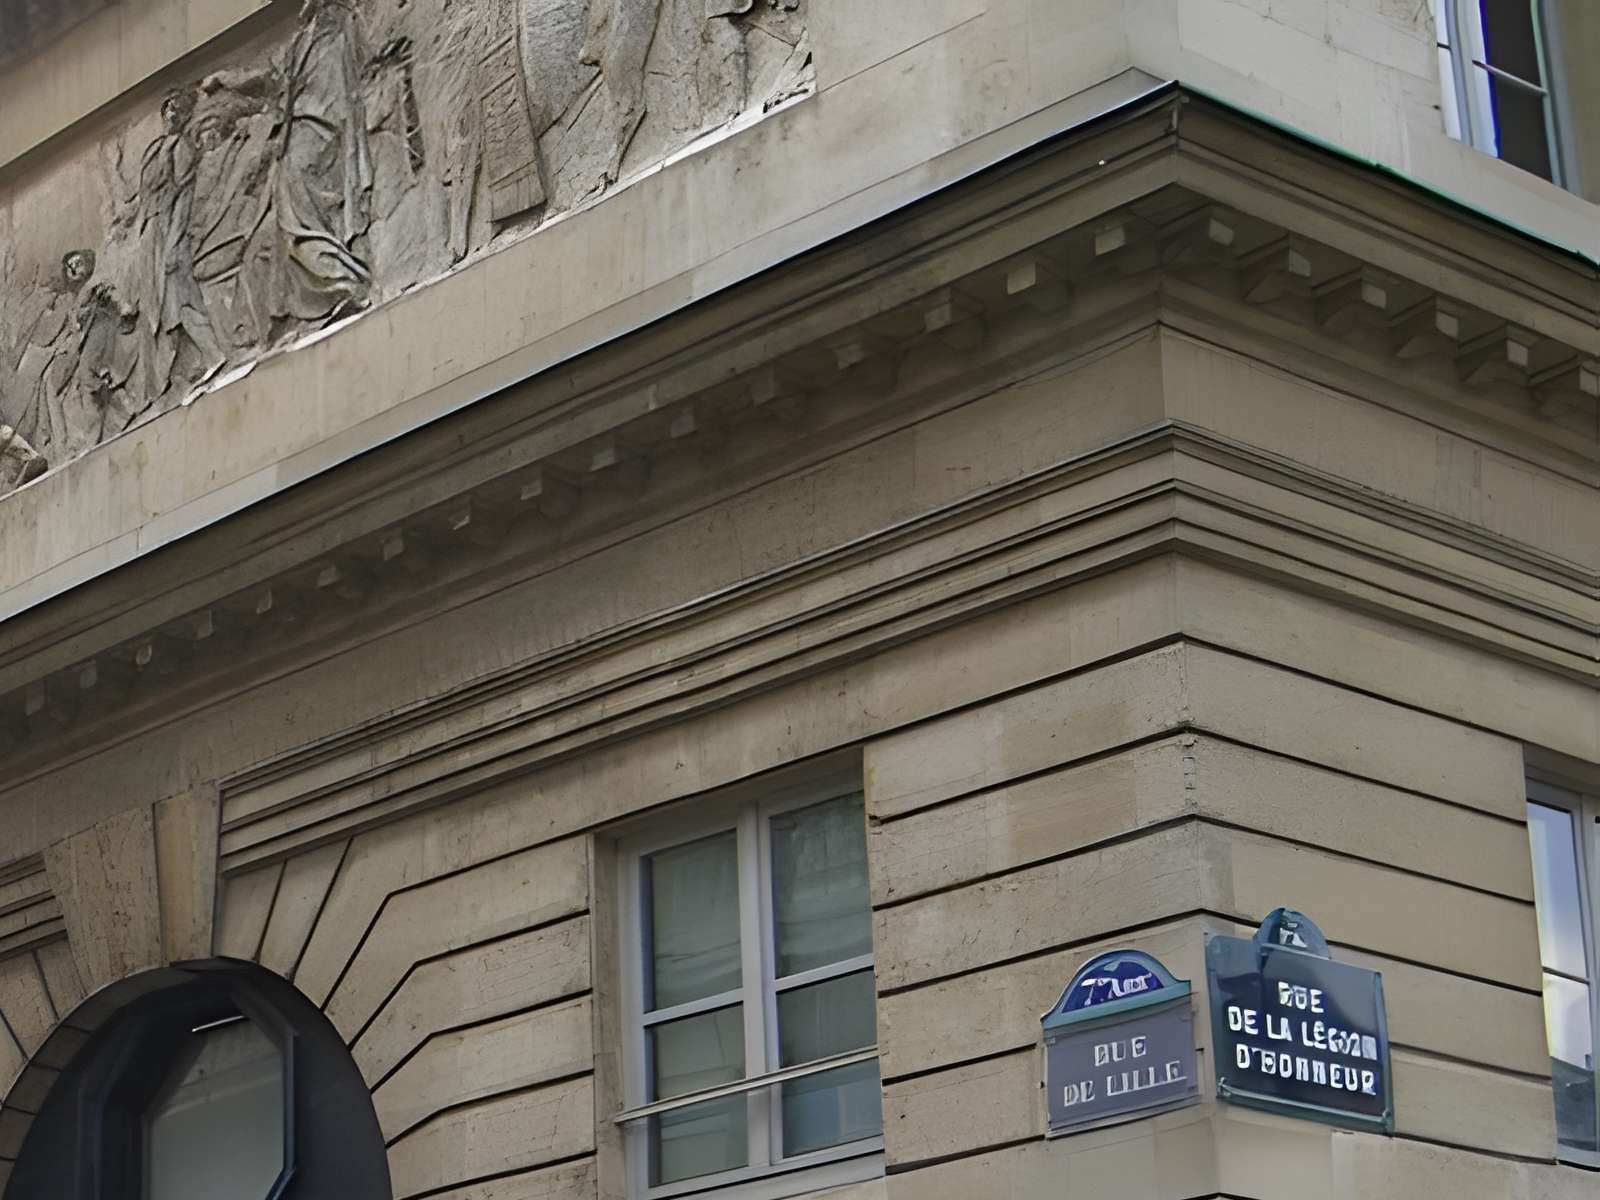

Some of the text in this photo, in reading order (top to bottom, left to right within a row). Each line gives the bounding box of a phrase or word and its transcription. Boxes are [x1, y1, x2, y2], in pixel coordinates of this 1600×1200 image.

[1277, 980, 1325, 1014] RUE
[1228, 1005, 1259, 1035] DE
[1266, 1013, 1293, 1042] LA
[1094, 1035, 1147, 1067] RUE
[1063, 1060, 1188, 1107] DE LILLE
